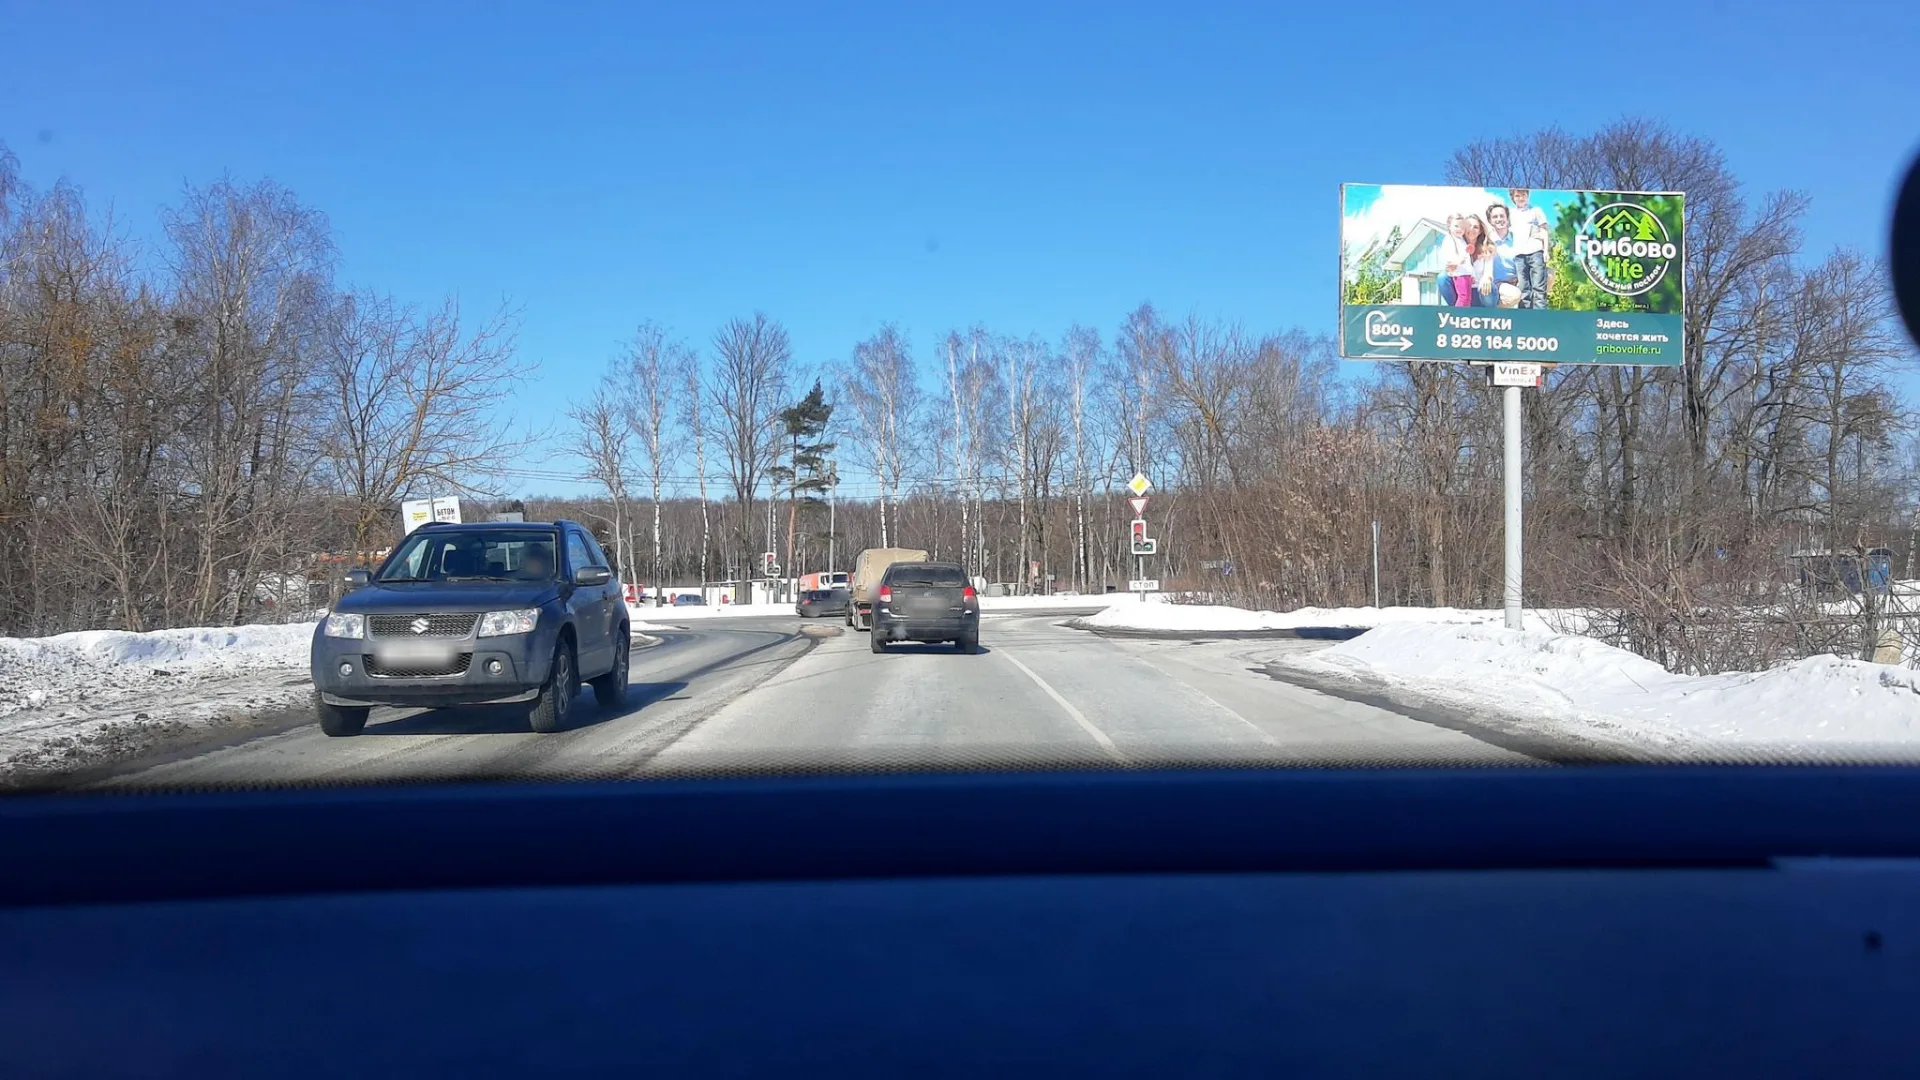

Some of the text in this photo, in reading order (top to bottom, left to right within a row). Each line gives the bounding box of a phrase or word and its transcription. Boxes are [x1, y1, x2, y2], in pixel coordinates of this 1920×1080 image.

[1574, 235, 1677, 259] Грибово
[1607, 256, 1644, 279] life
[1438, 312, 1512, 331] Участки
[1596, 318, 1629, 329] Здесь
[1372, 323, 1401, 336] 800
[1436, 333, 1559, 351] 8 926 164 5000
[1596, 332, 1669, 343] хочется жить
[1596, 344, 1662, 355] gribovolife.ru
